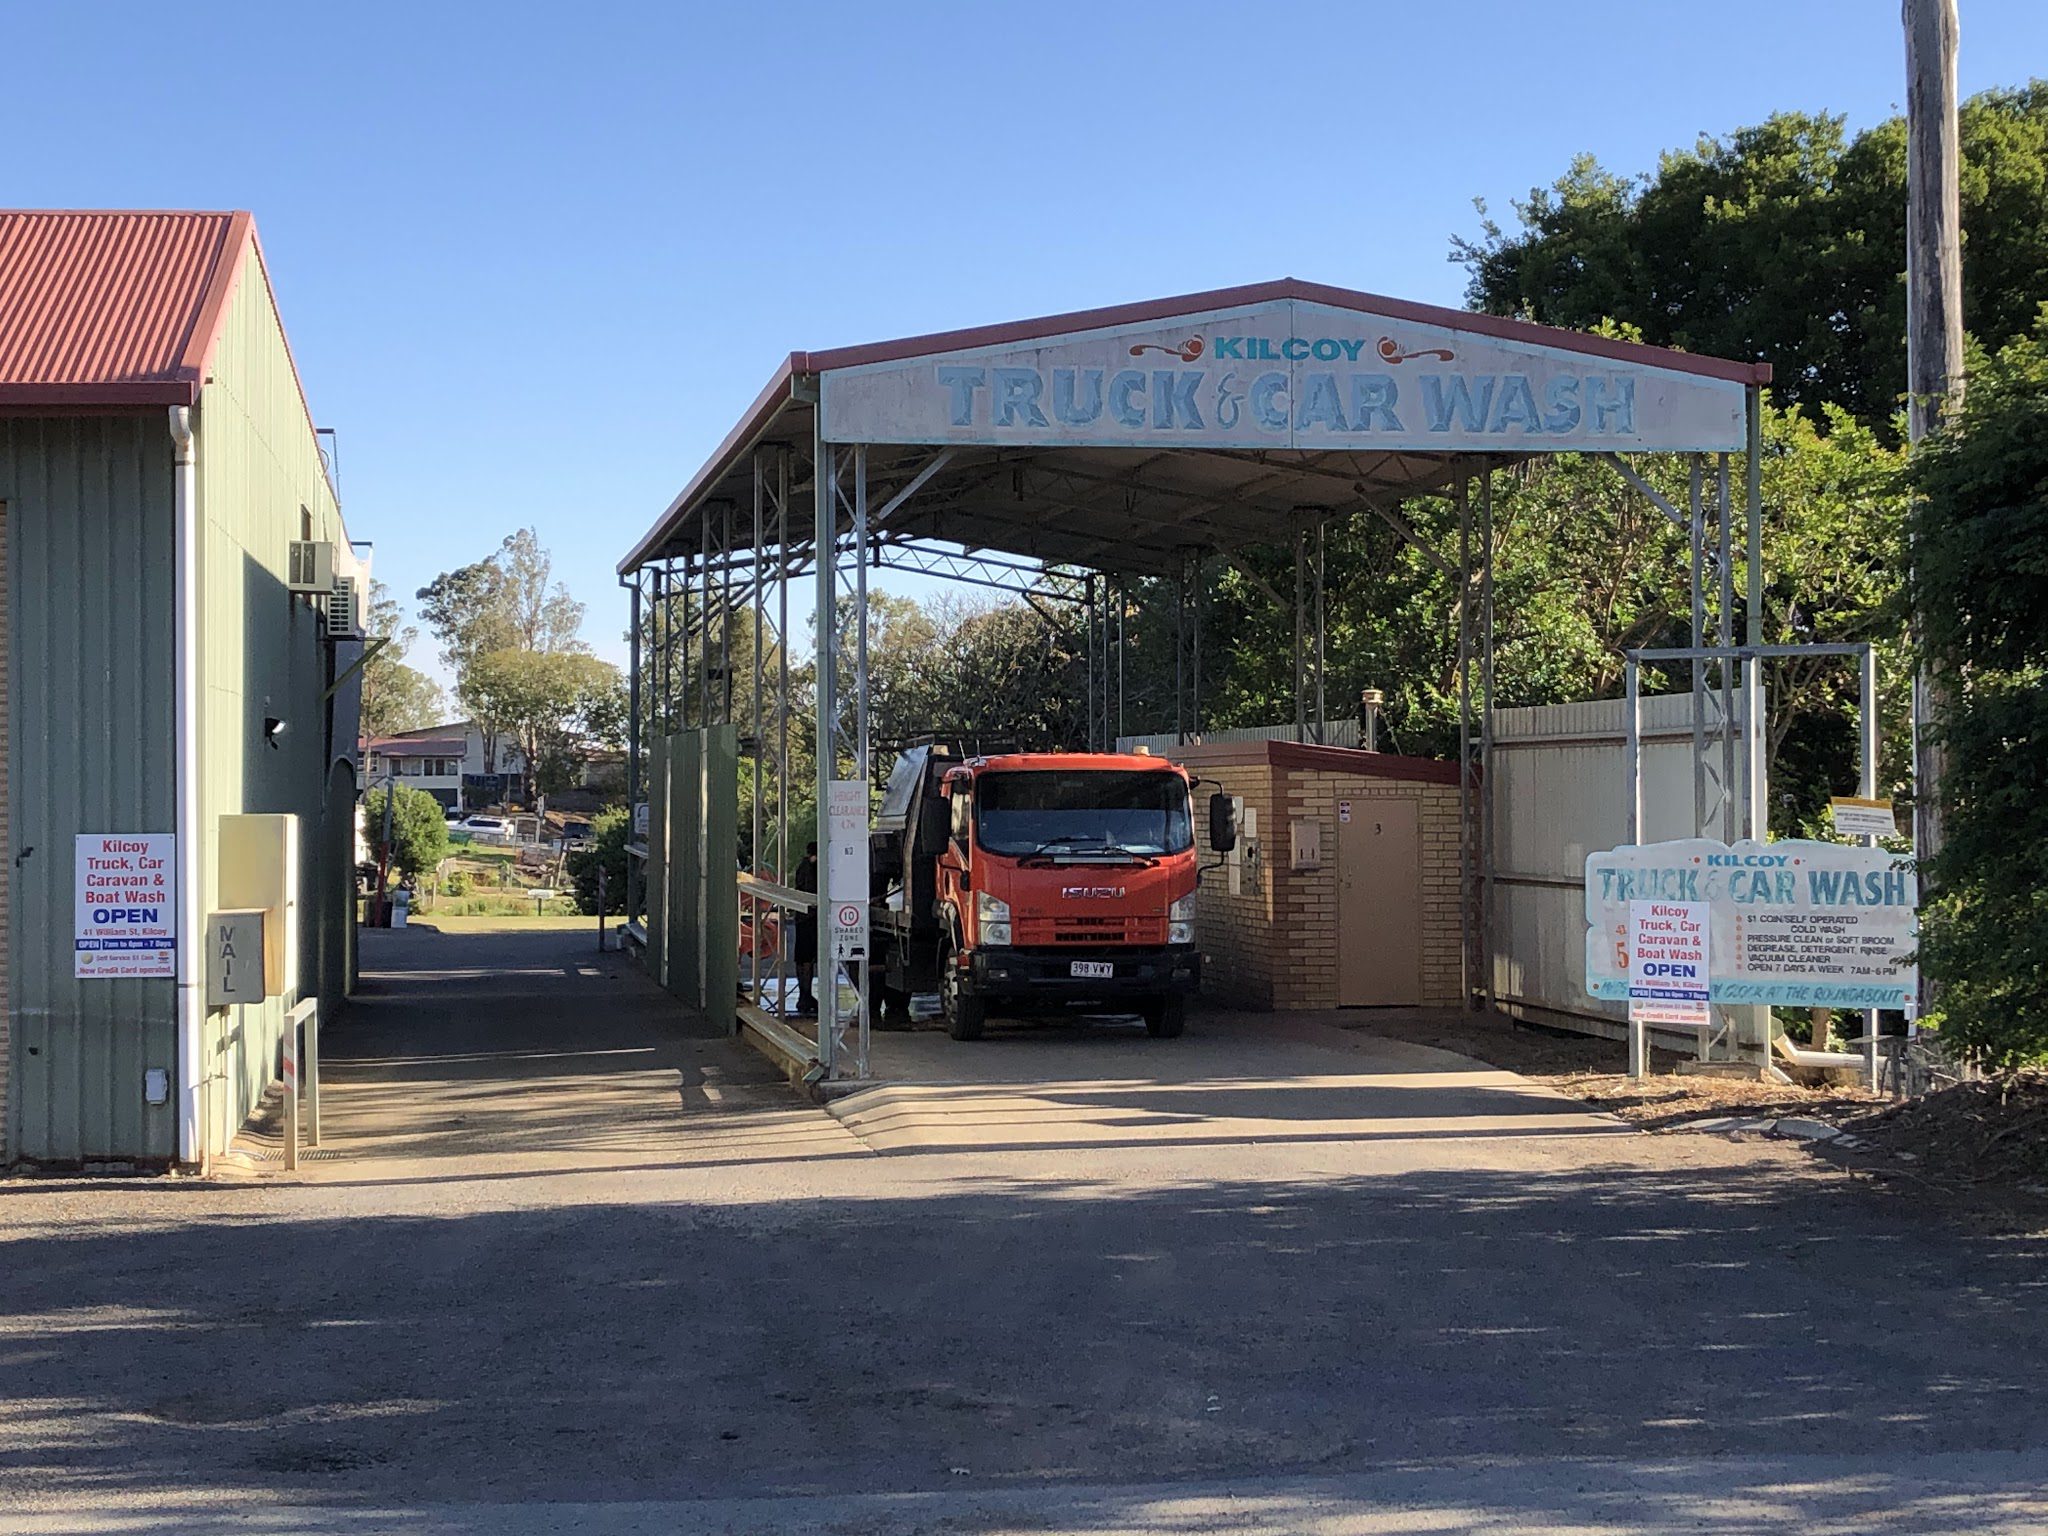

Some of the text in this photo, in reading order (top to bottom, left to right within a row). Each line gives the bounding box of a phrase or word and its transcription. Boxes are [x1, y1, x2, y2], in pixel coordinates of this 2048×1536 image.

[1215, 337, 1365, 362] KILCOY
[937, 366, 1636, 435] TRUCK & CAR WASH
[102, 839, 149, 855] Kilcoy
[87, 856, 164, 871] Truck, Car
[1707, 854, 1788, 867] KILCOY
[86, 873, 165, 887] Caravan &
[1062, 887, 1126, 899] ISUZU
[1597, 868, 1700, 902] TRUCK
[1728, 870, 1796, 904] CAR
[1808, 870, 1906, 906] WASH
[85, 890, 166, 904] Boat Wash
[93, 908, 158, 924] OPEN
[844, 911, 855, 921] 10
[1651, 905, 1689, 919] Kilcoy
[1639, 919, 1677, 932] Truck,
[1680, 920, 1701, 932] Car
[1747, 915, 1757, 923] $1
[1809, 915, 1858, 924] OPERATED
[96, 928, 127, 936] William
[142, 928, 167, 936] Kilcoy
[1790, 925, 1845, 934] COLD WASH
[839, 934, 859, 942] ZONE
[1638, 933, 1701, 946] Caravan &
[1747, 935, 1790, 943] PRESSURE
[1793, 935, 1823, 944] CLEAN
[1837, 936, 1859, 944] SOFT
[1862, 937, 1895, 945] BROOM
[78, 941, 99, 949] OPEN
[220, 925, 236, 992] MAIL
[1637, 947, 1702, 961] Boat Wash
[1748, 954, 1831, 963] VACUUM CLEANER
[97, 966, 118, 974] Credit
[120, 966, 137, 974] Card
[1073, 963, 1090, 973] 398
[1643, 963, 1696, 977] OPEN
[1747, 963, 1772, 972] OPEN
[1776, 964, 1781, 972] 7
[1784, 964, 1805, 973] DAYS
[1808, 964, 1816, 973] A
[1818, 965, 1844, 974] WEEK
[1786, 985, 1811, 1001] THE
[1813, 986, 1903, 1004] ROUNDABOUT
